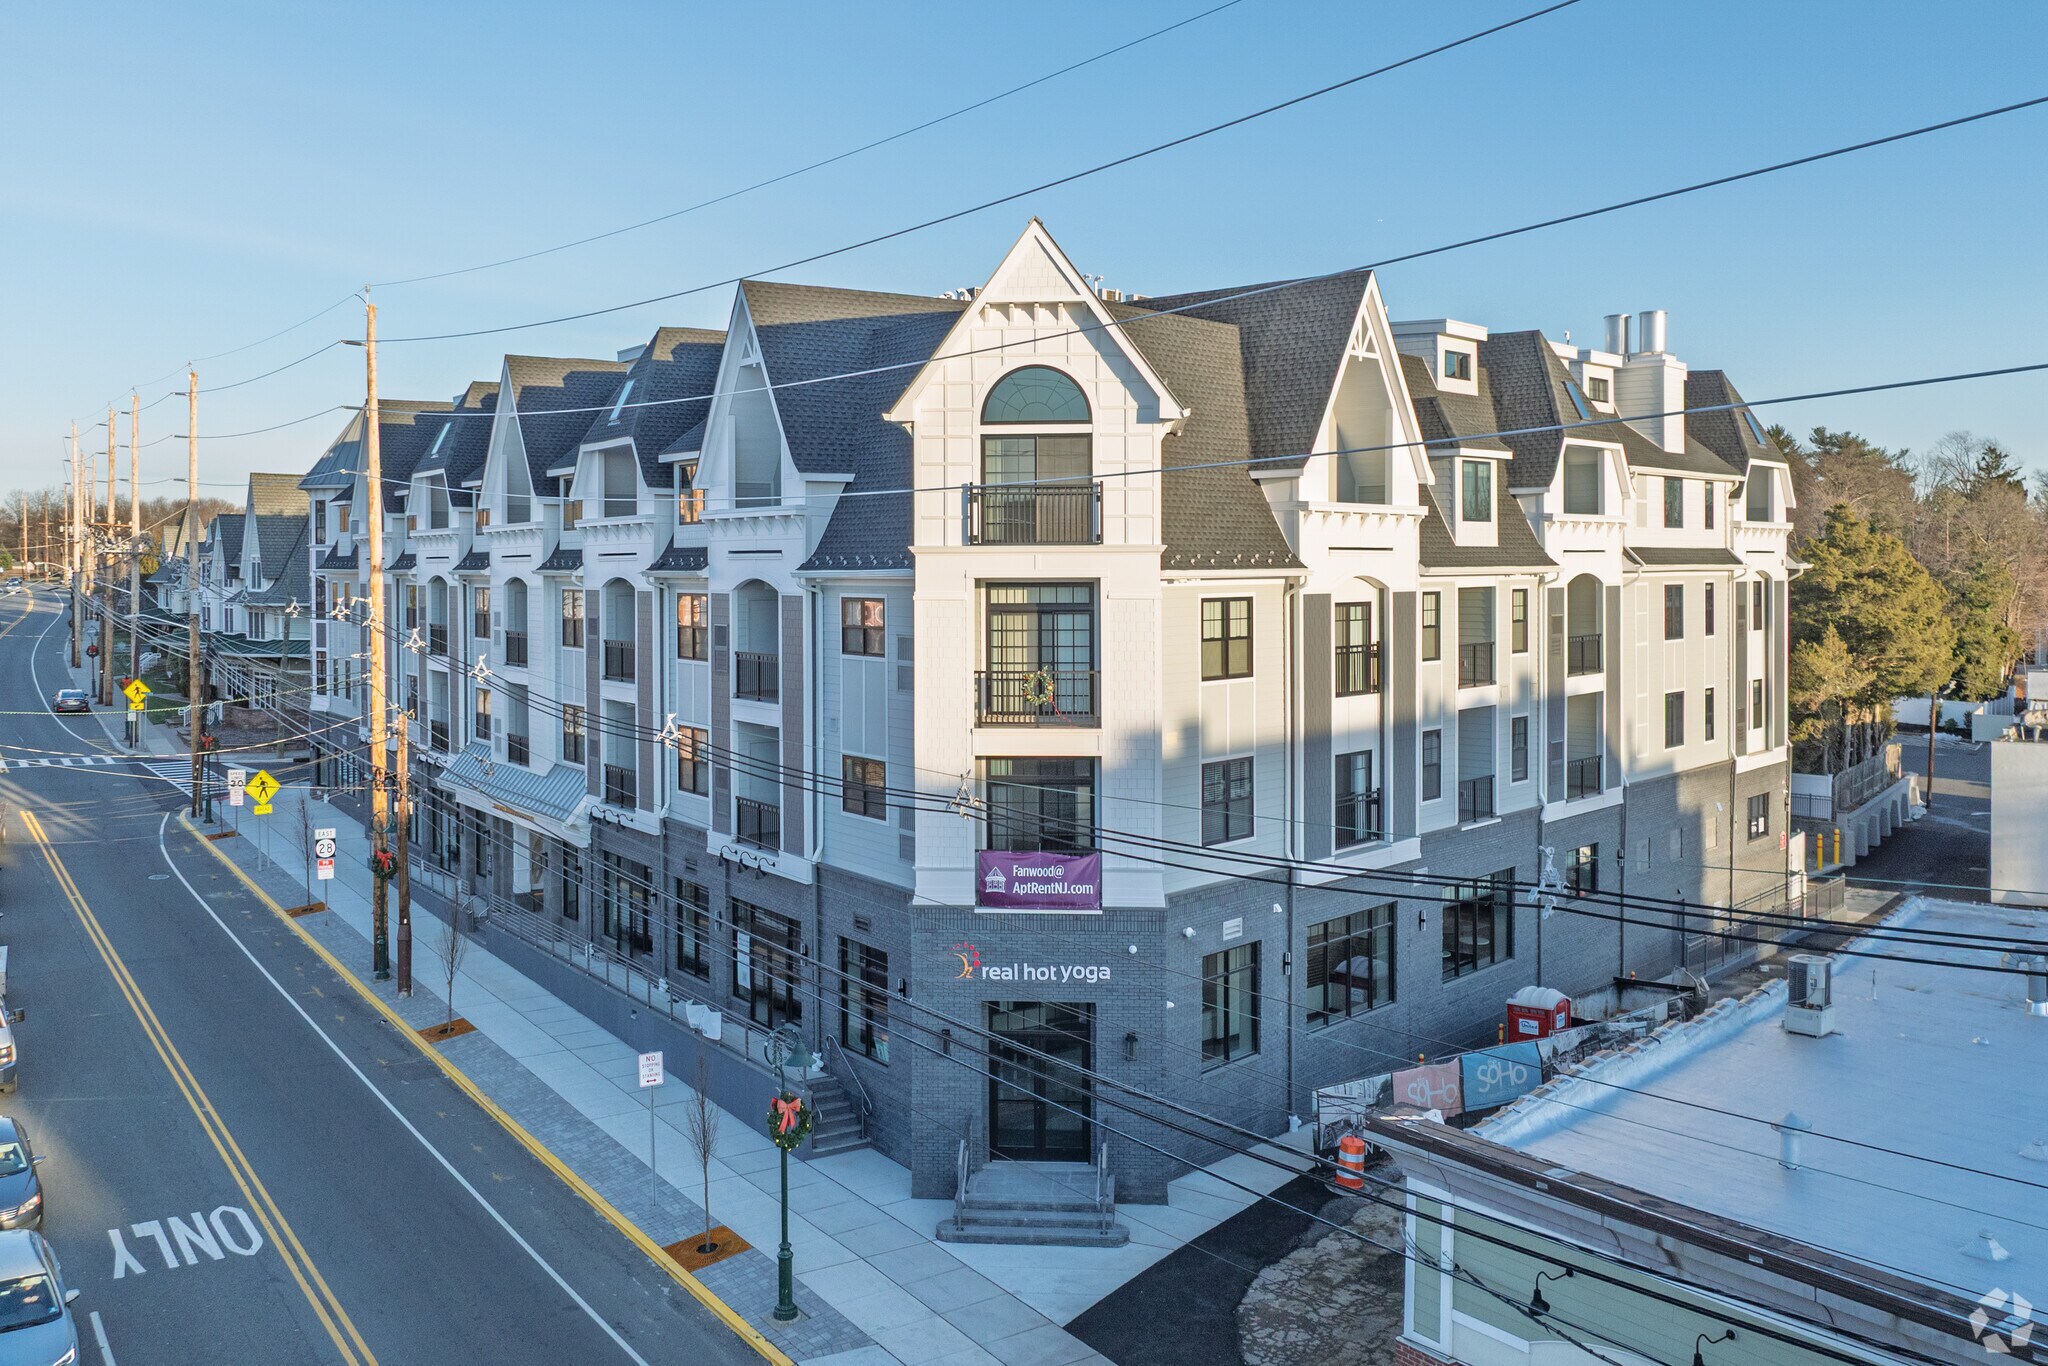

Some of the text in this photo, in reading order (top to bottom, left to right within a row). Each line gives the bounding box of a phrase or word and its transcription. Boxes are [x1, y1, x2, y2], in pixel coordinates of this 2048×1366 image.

[319, 843, 333, 854] 28
[1012, 864, 1065, 879] Fanwood@
[1012, 882, 1094, 896] AptRentNJ.com
[981, 963, 1111, 983] real hot yoga
[107, 1205, 263, 1279] ONLY
